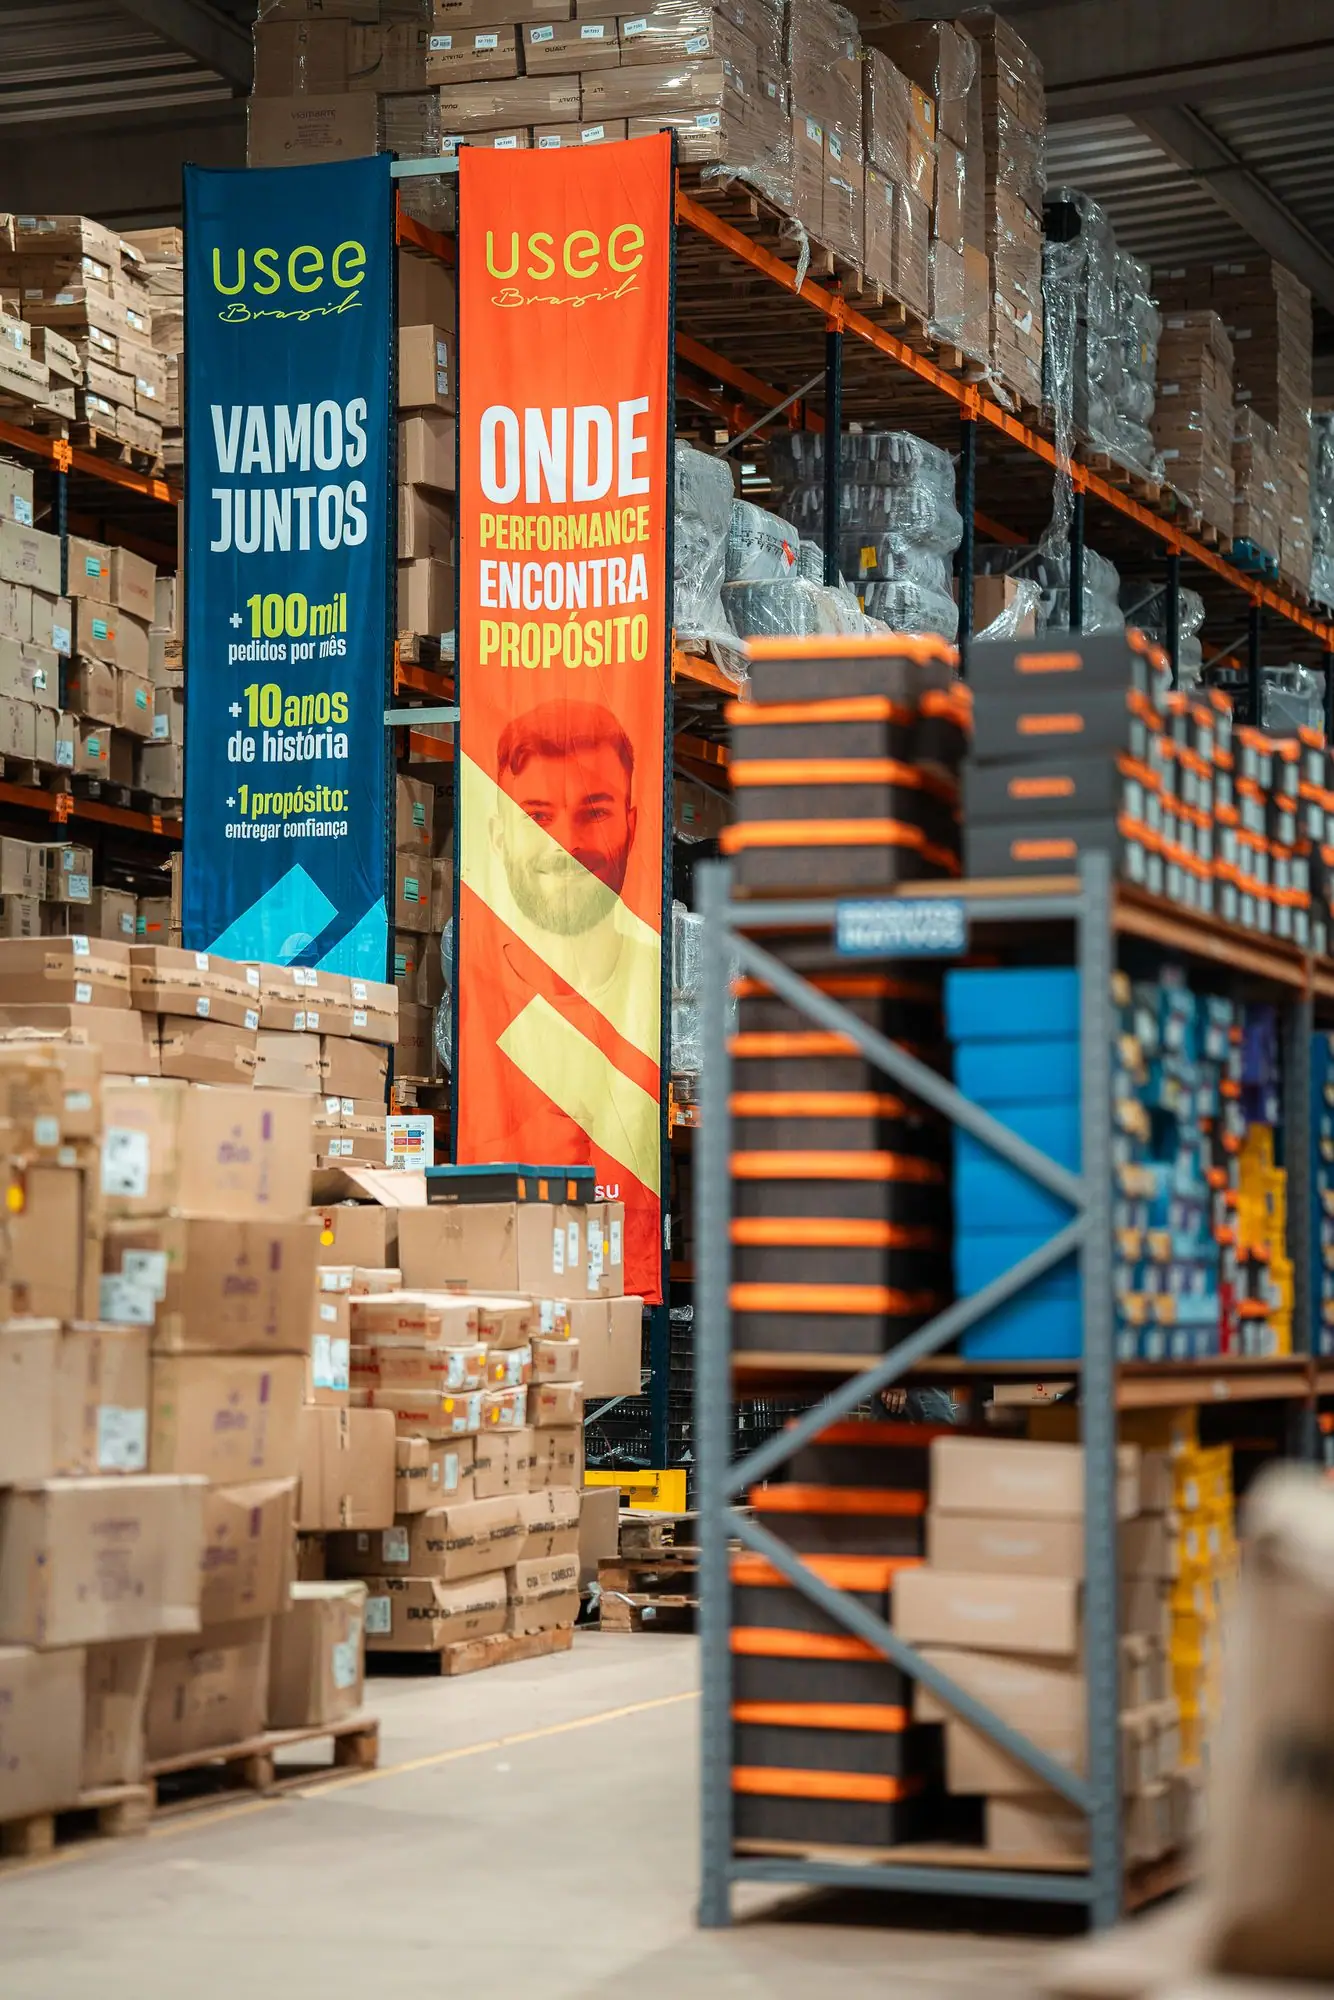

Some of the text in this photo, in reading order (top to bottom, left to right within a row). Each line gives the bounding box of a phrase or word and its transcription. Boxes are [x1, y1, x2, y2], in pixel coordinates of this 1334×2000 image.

[218, 290, 363, 323] Brasil
[491, 273, 640, 308] Brasil
[211, 397, 367, 474] VAMOS
[480, 396, 650, 504] ONDE
[210, 480, 367, 553] JUNTOS
[480, 505, 650, 551] PERFORMANCE
[479, 553, 649, 610] ENCONTRA
[228, 635, 347, 666] pedidos por mês
[479, 612, 649, 669] PROPÓSITO
[227, 726, 349, 763] de história
[225, 818, 348, 842] entregar confiança
